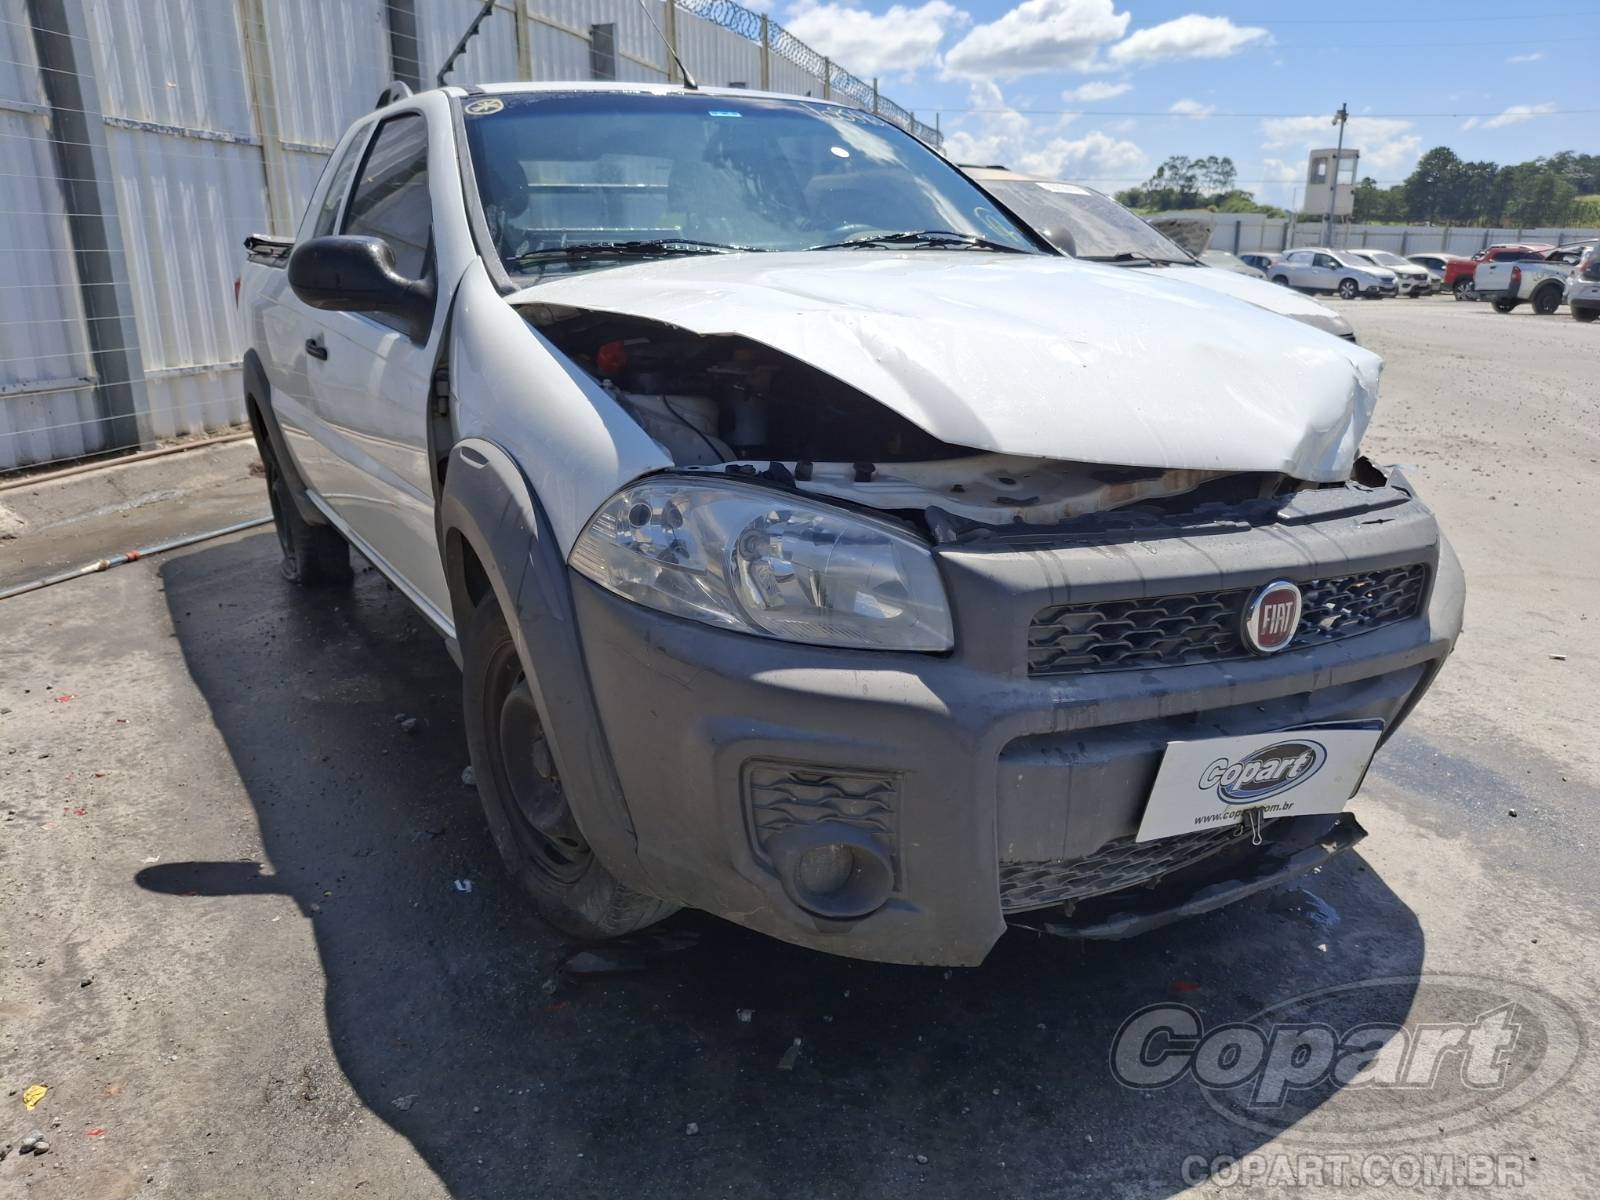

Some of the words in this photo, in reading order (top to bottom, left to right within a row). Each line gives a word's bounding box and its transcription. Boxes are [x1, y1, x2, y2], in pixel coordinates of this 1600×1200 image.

[1260, 601, 1293, 635] FIAT
[1199, 749, 1316, 792] Copart
[1195, 801, 1294, 825] www.copom.br
